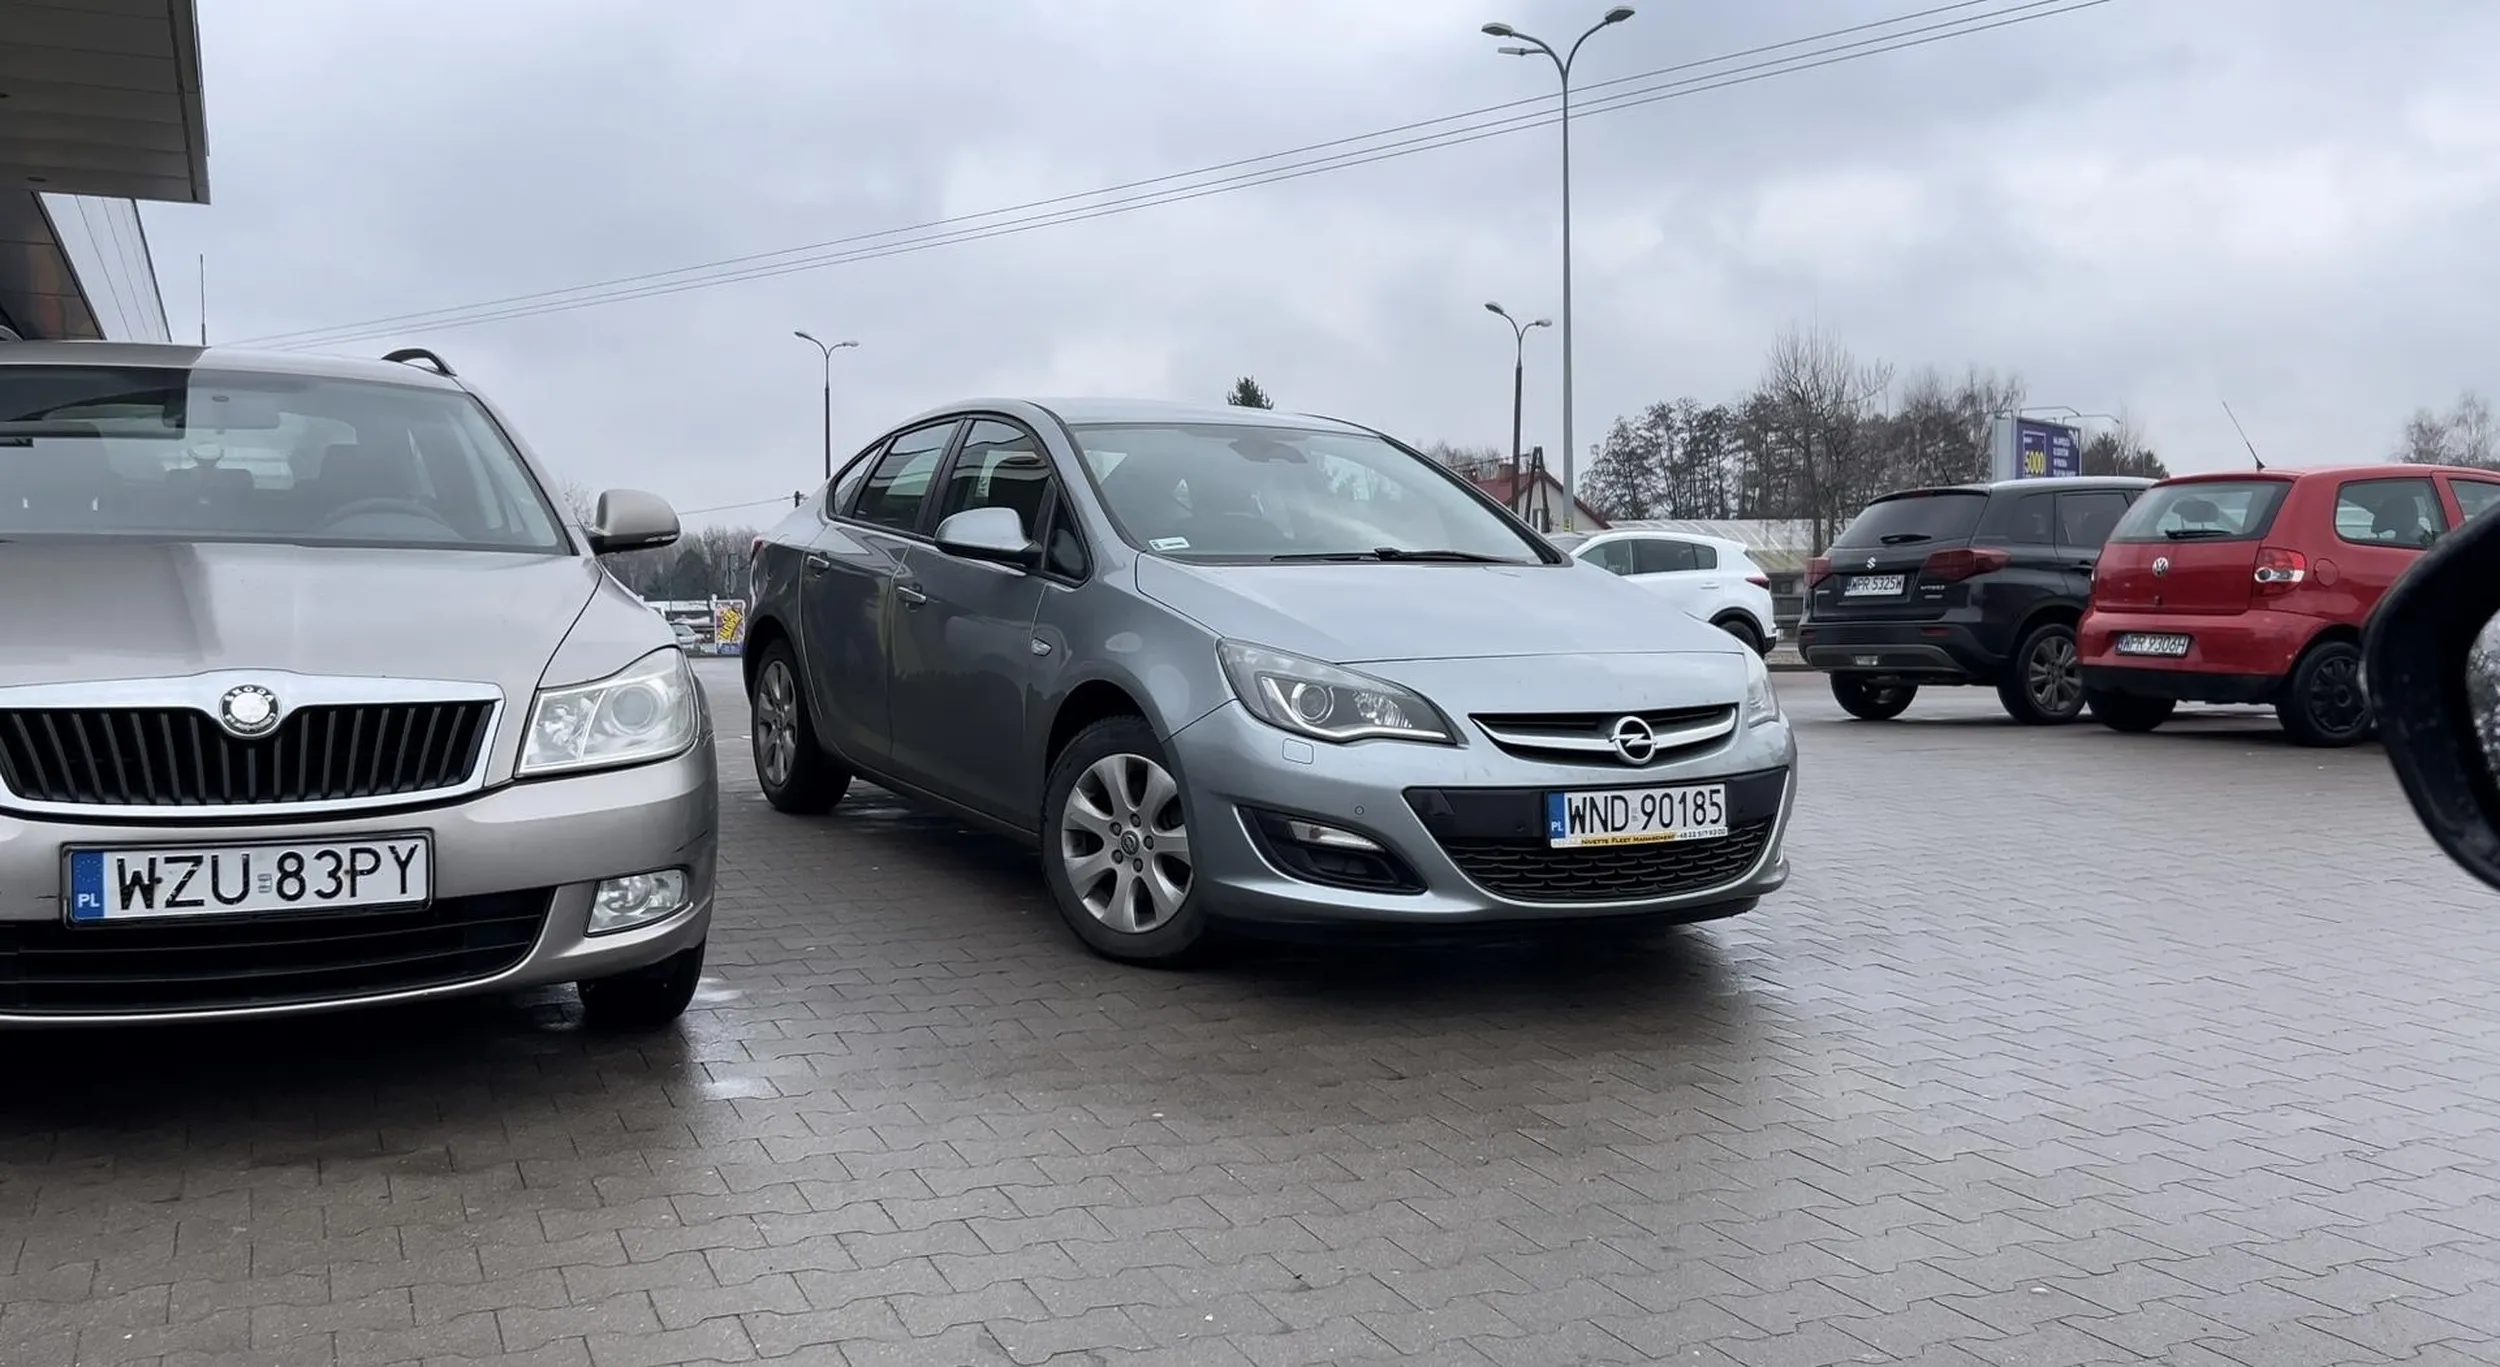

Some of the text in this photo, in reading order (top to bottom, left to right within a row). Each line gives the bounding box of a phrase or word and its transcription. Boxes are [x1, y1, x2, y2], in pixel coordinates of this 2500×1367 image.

[2025, 451, 2044, 475] 5000
[2122, 635, 2146, 651] WPR
[1567, 789, 1722, 834] WND 90185
[1551, 821, 1564, 832] PL
[116, 843, 419, 911] WZU 83PY
[78, 892, 100, 908] PL
